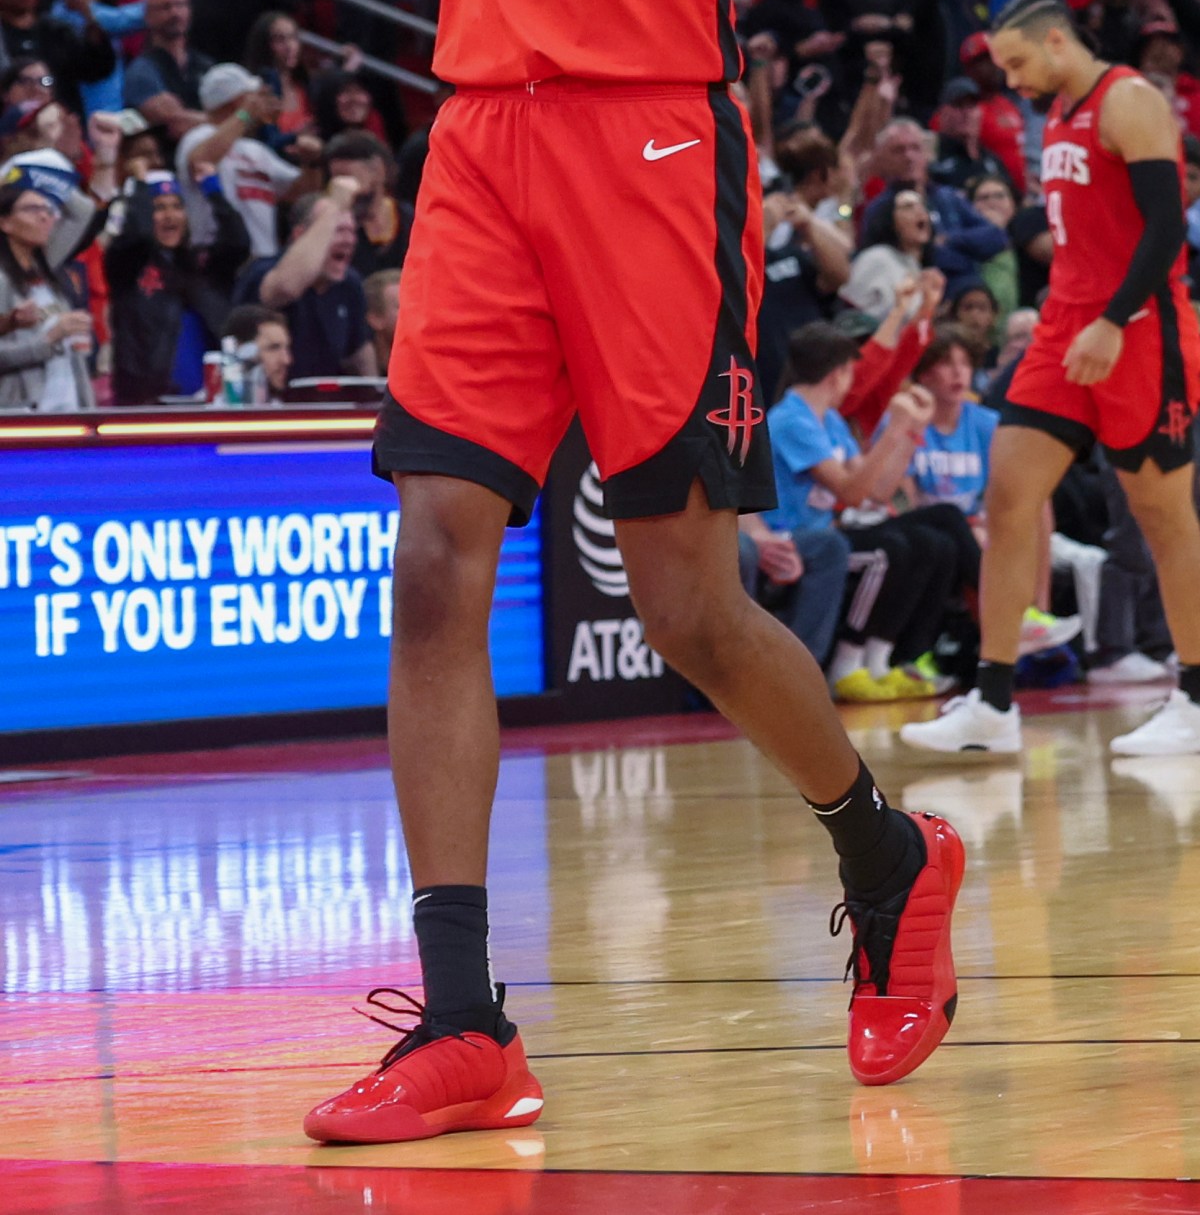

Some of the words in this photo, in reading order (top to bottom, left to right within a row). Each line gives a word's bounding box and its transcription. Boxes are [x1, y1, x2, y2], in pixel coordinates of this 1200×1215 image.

[92, 517, 220, 584] ONLY
[227, 510, 400, 577] WORTH
[35, 592, 80, 657] IF
[91, 586, 197, 653] YOU
[209, 578, 368, 646] ENJOY
